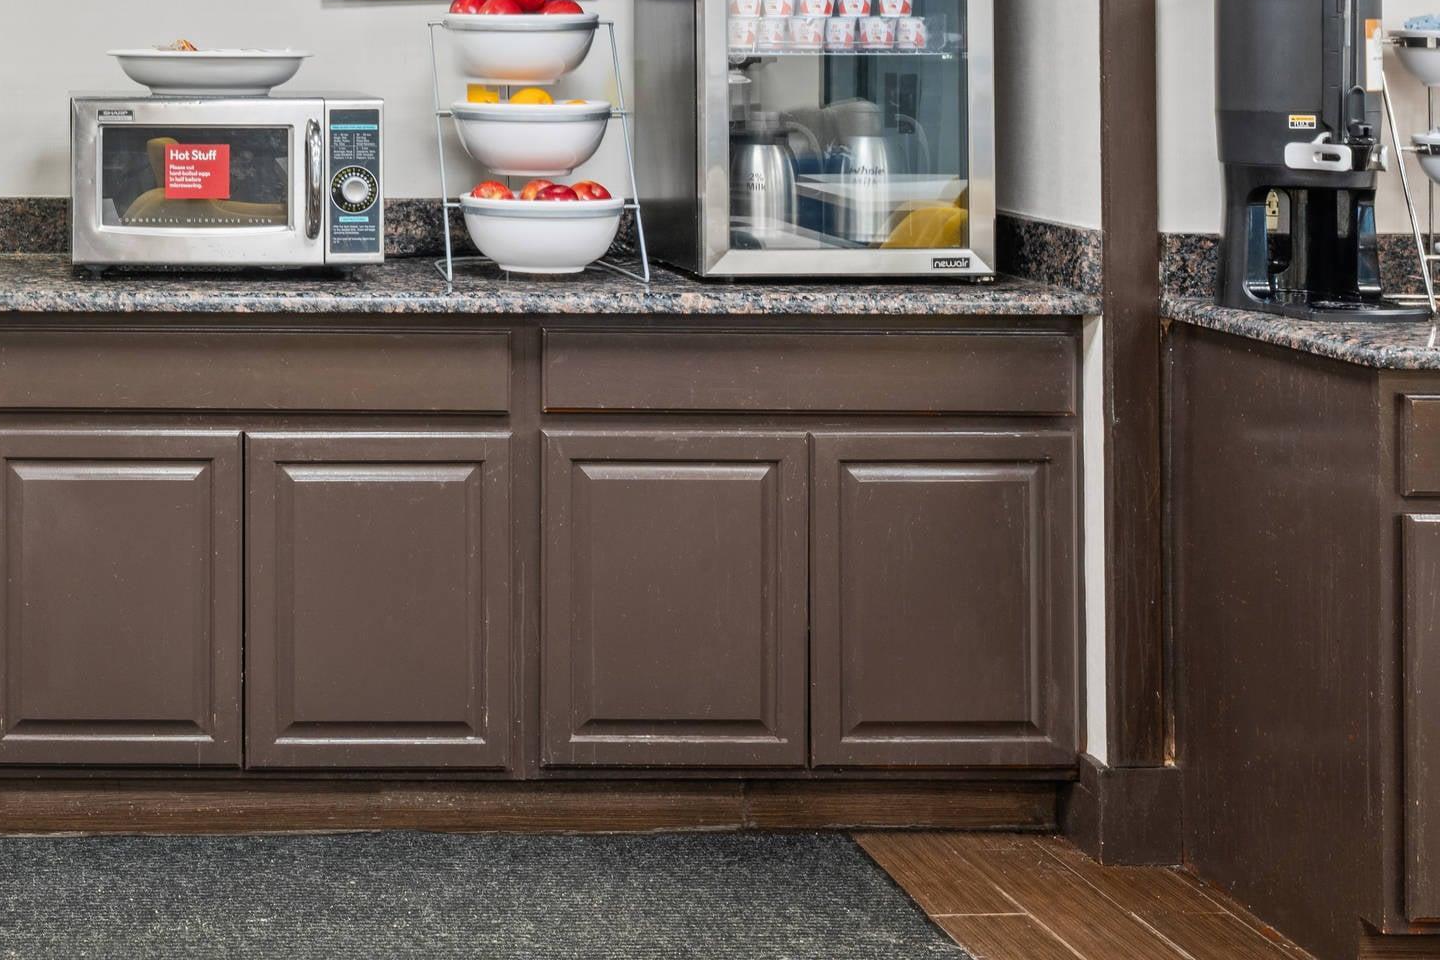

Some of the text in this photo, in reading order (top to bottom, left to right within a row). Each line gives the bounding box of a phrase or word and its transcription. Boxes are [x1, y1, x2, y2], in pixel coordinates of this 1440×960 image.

[169, 149, 217, 161] Hot Stuff
[934, 258, 969, 268] newair
